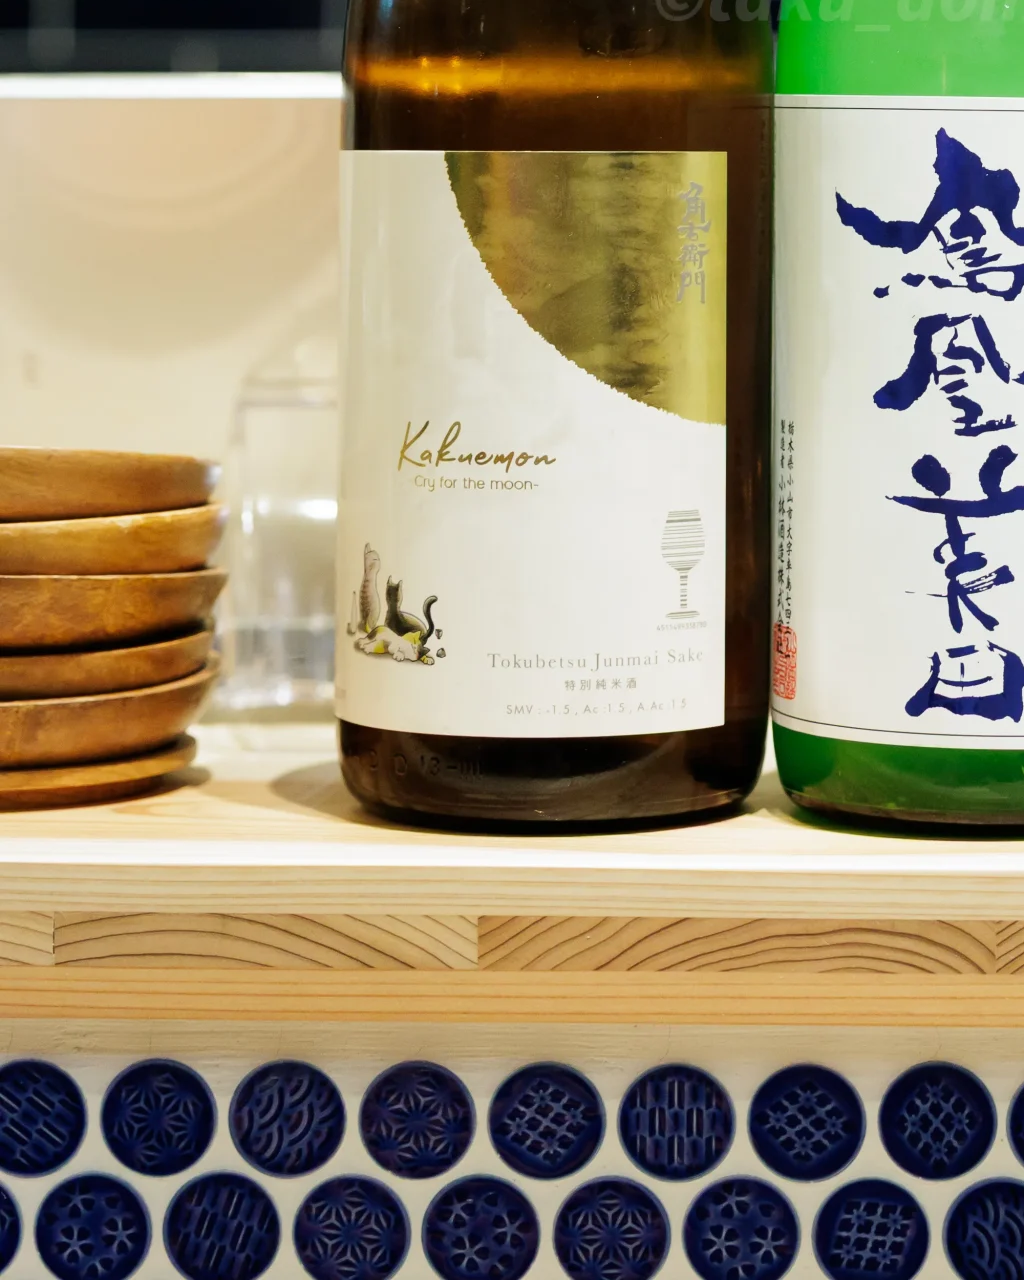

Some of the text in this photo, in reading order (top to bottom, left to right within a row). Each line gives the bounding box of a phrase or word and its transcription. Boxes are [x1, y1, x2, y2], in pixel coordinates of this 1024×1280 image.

[397, 420, 557, 473] Kakuemon
[414, 475, 435, 492] Cry
[440, 476, 458, 489] for
[463, 477, 485, 489] the
[487, 648, 704, 672] Tokubetsu Junmai Sake
[564, 677, 637, 692] 特別純米酒
